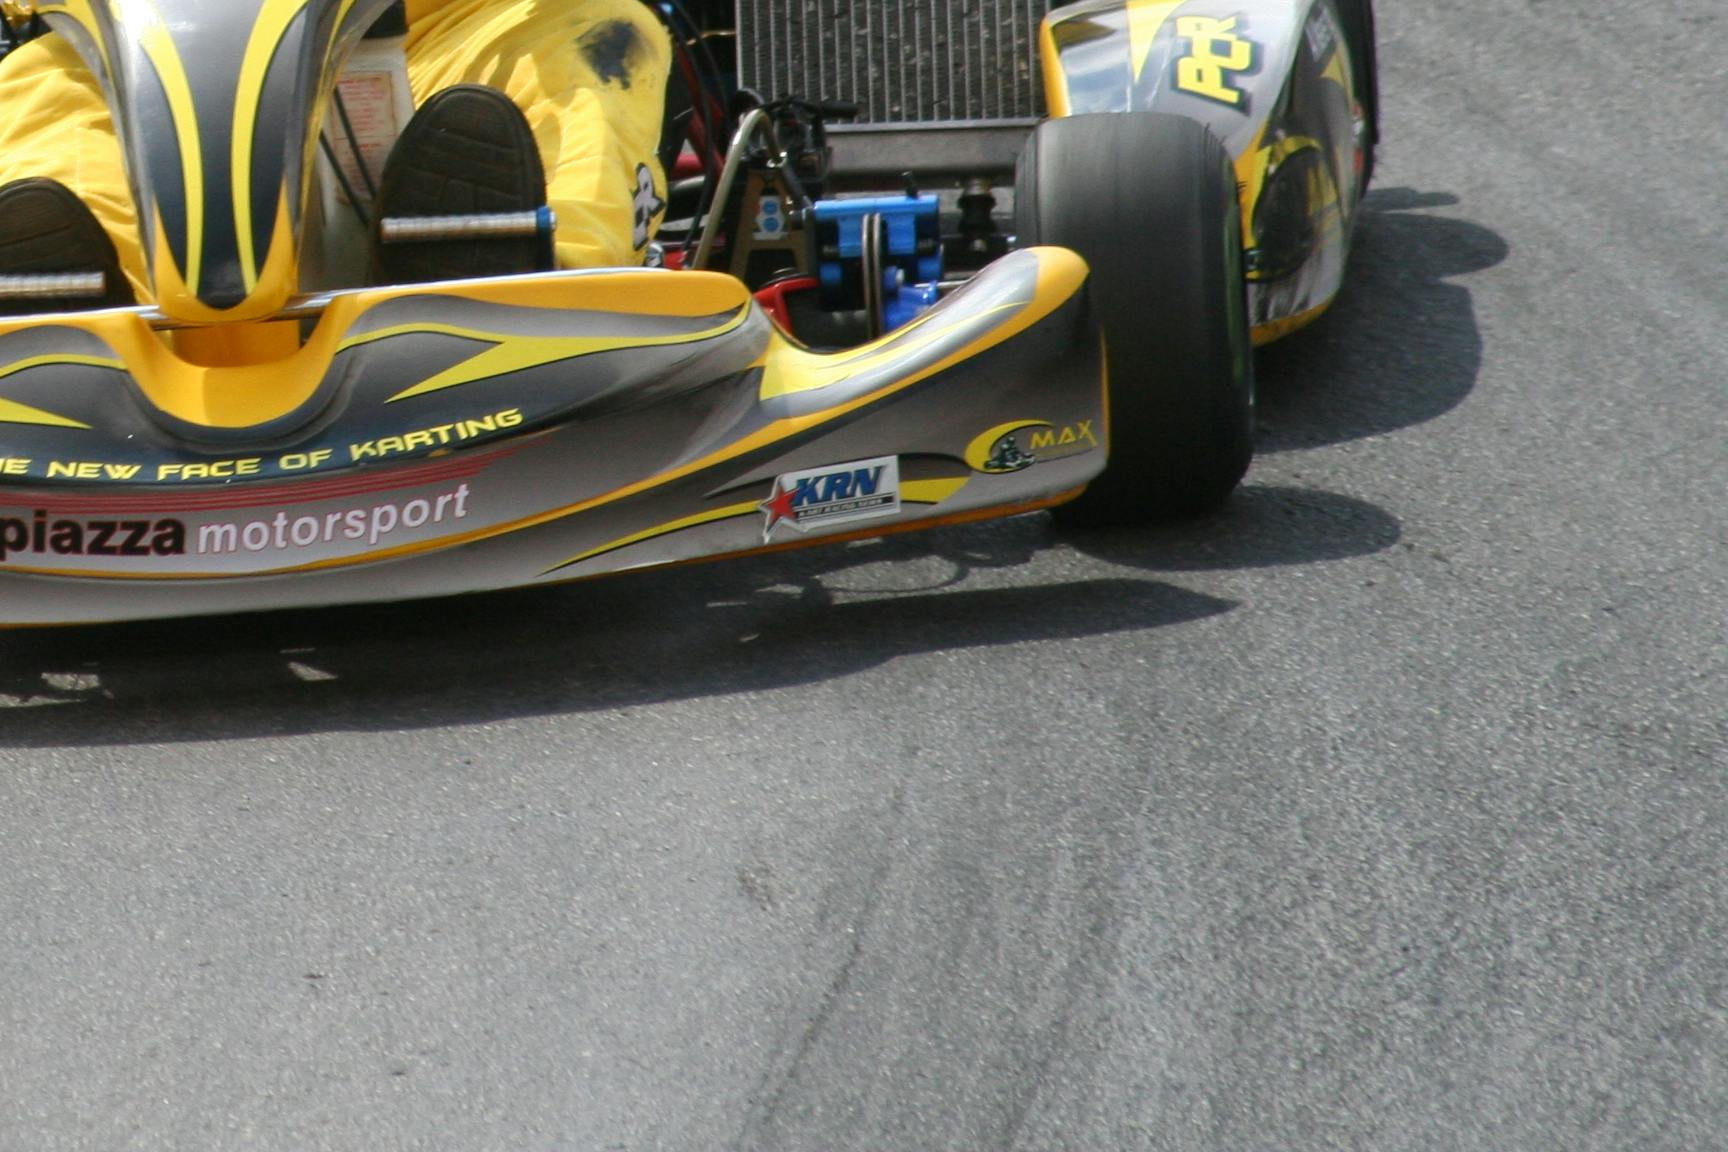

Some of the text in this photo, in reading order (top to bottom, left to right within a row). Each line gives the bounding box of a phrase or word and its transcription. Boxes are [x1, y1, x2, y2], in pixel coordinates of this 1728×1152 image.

[46, 460, 142, 481] NEW
[157, 457, 262, 481] FACE
[278, 448, 334, 471] OF
[350, 408, 524, 462] KARTING
[1029, 419, 1098, 450] MAX
[792, 464, 888, 507] KRN
[196, 483, 470, 556] motorsport
